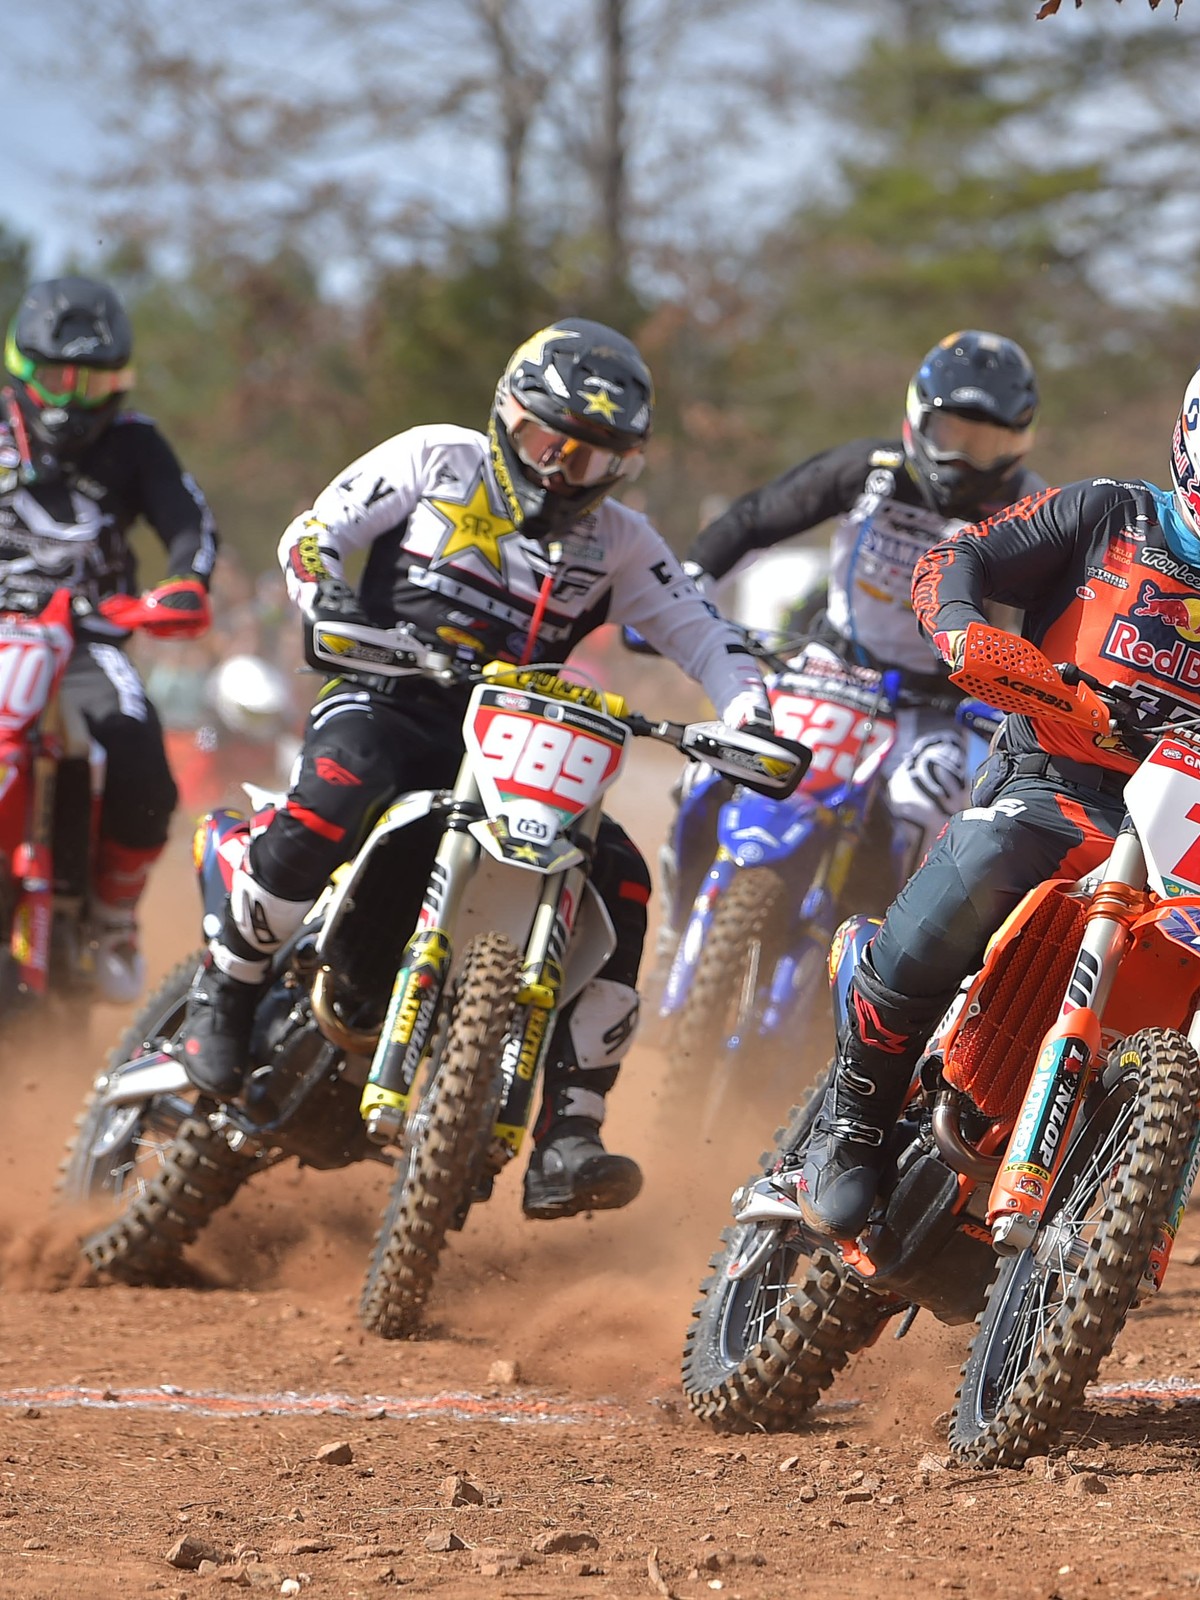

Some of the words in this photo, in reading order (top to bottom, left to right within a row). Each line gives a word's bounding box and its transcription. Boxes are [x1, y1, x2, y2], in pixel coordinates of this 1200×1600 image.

[1107, 551, 1132, 566] FARGO
[1109, 543, 1133, 558] WELLS
[1141, 547, 1176, 575] Troy
[1096, 568, 1129, 586] TRAIL
[481, 713, 612, 801] 989
[1008, 1071, 1050, 1163] MOTOREX
